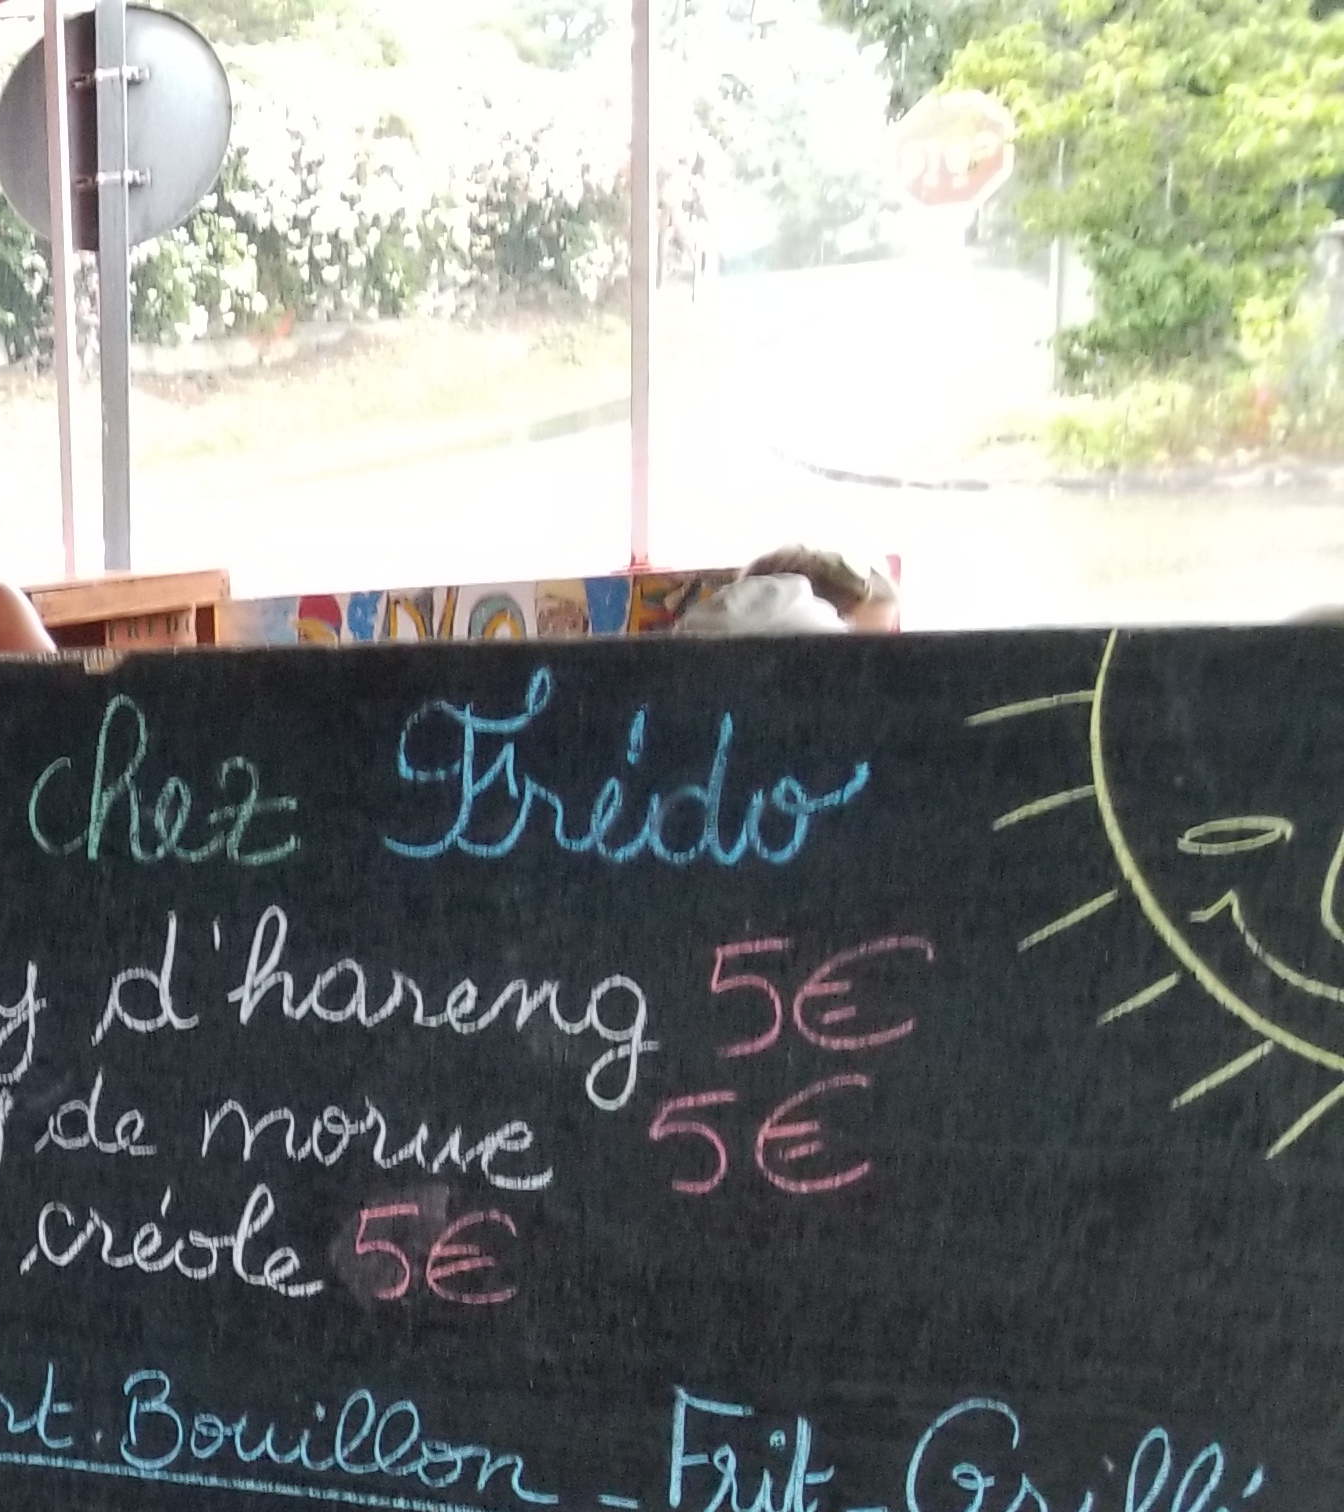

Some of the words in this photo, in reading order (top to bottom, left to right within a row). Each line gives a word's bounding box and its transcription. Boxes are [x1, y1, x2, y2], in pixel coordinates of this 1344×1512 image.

[382, 667, 872, 866] Frédo
[711, 935, 935, 1058] 5€
[34, 1067, 158, 1156] de
[649, 1073, 872, 1195] 5€
[354, 1200, 518, 1304] 5€
